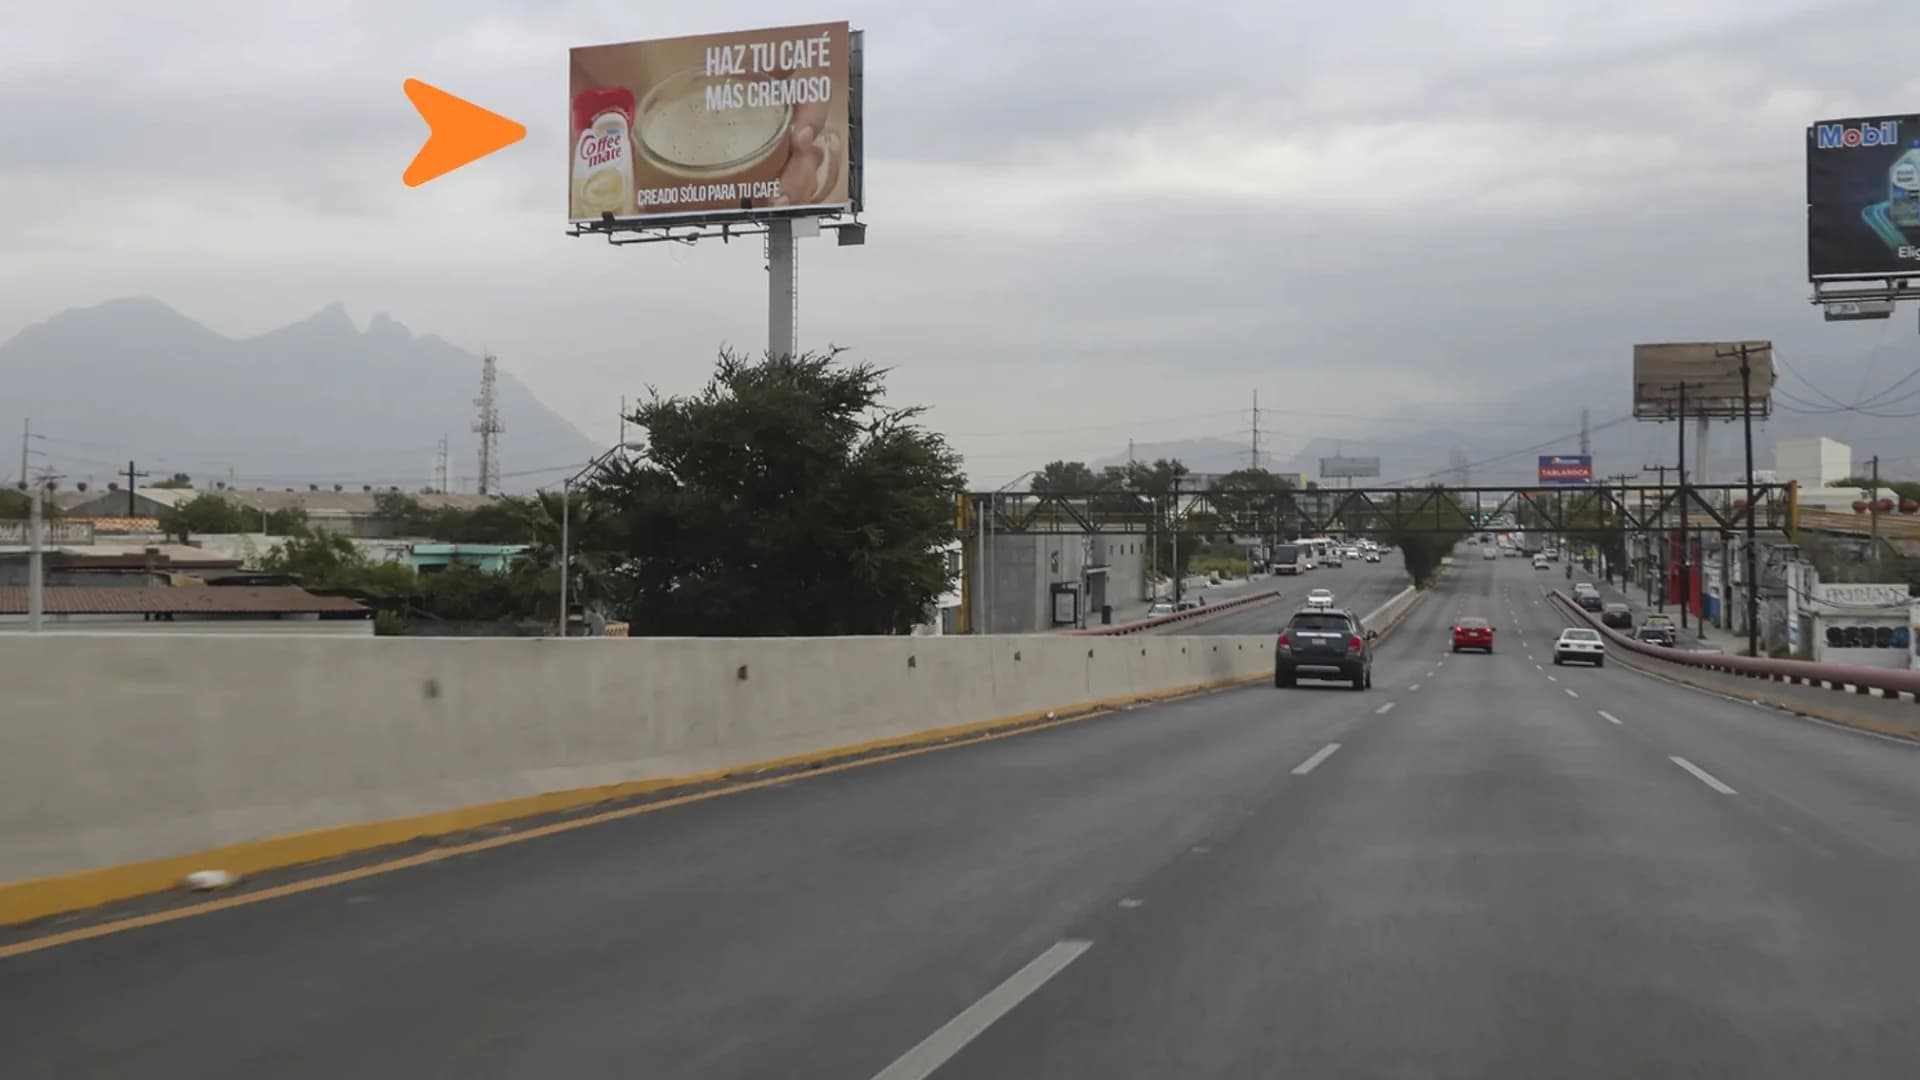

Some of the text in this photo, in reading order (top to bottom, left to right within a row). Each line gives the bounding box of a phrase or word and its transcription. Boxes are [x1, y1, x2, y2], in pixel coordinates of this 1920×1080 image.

[706, 31, 831, 76] HAZ TU CAFÉ
[706, 76, 831, 111] MÁS CREMOSO
[580, 135, 621, 160] Coffee
[1818, 121, 1897, 148] Mobil
[589, 147, 622, 168] mate
[637, 179, 780, 206] CREADO SÓLO PARA TU CAFÉ
